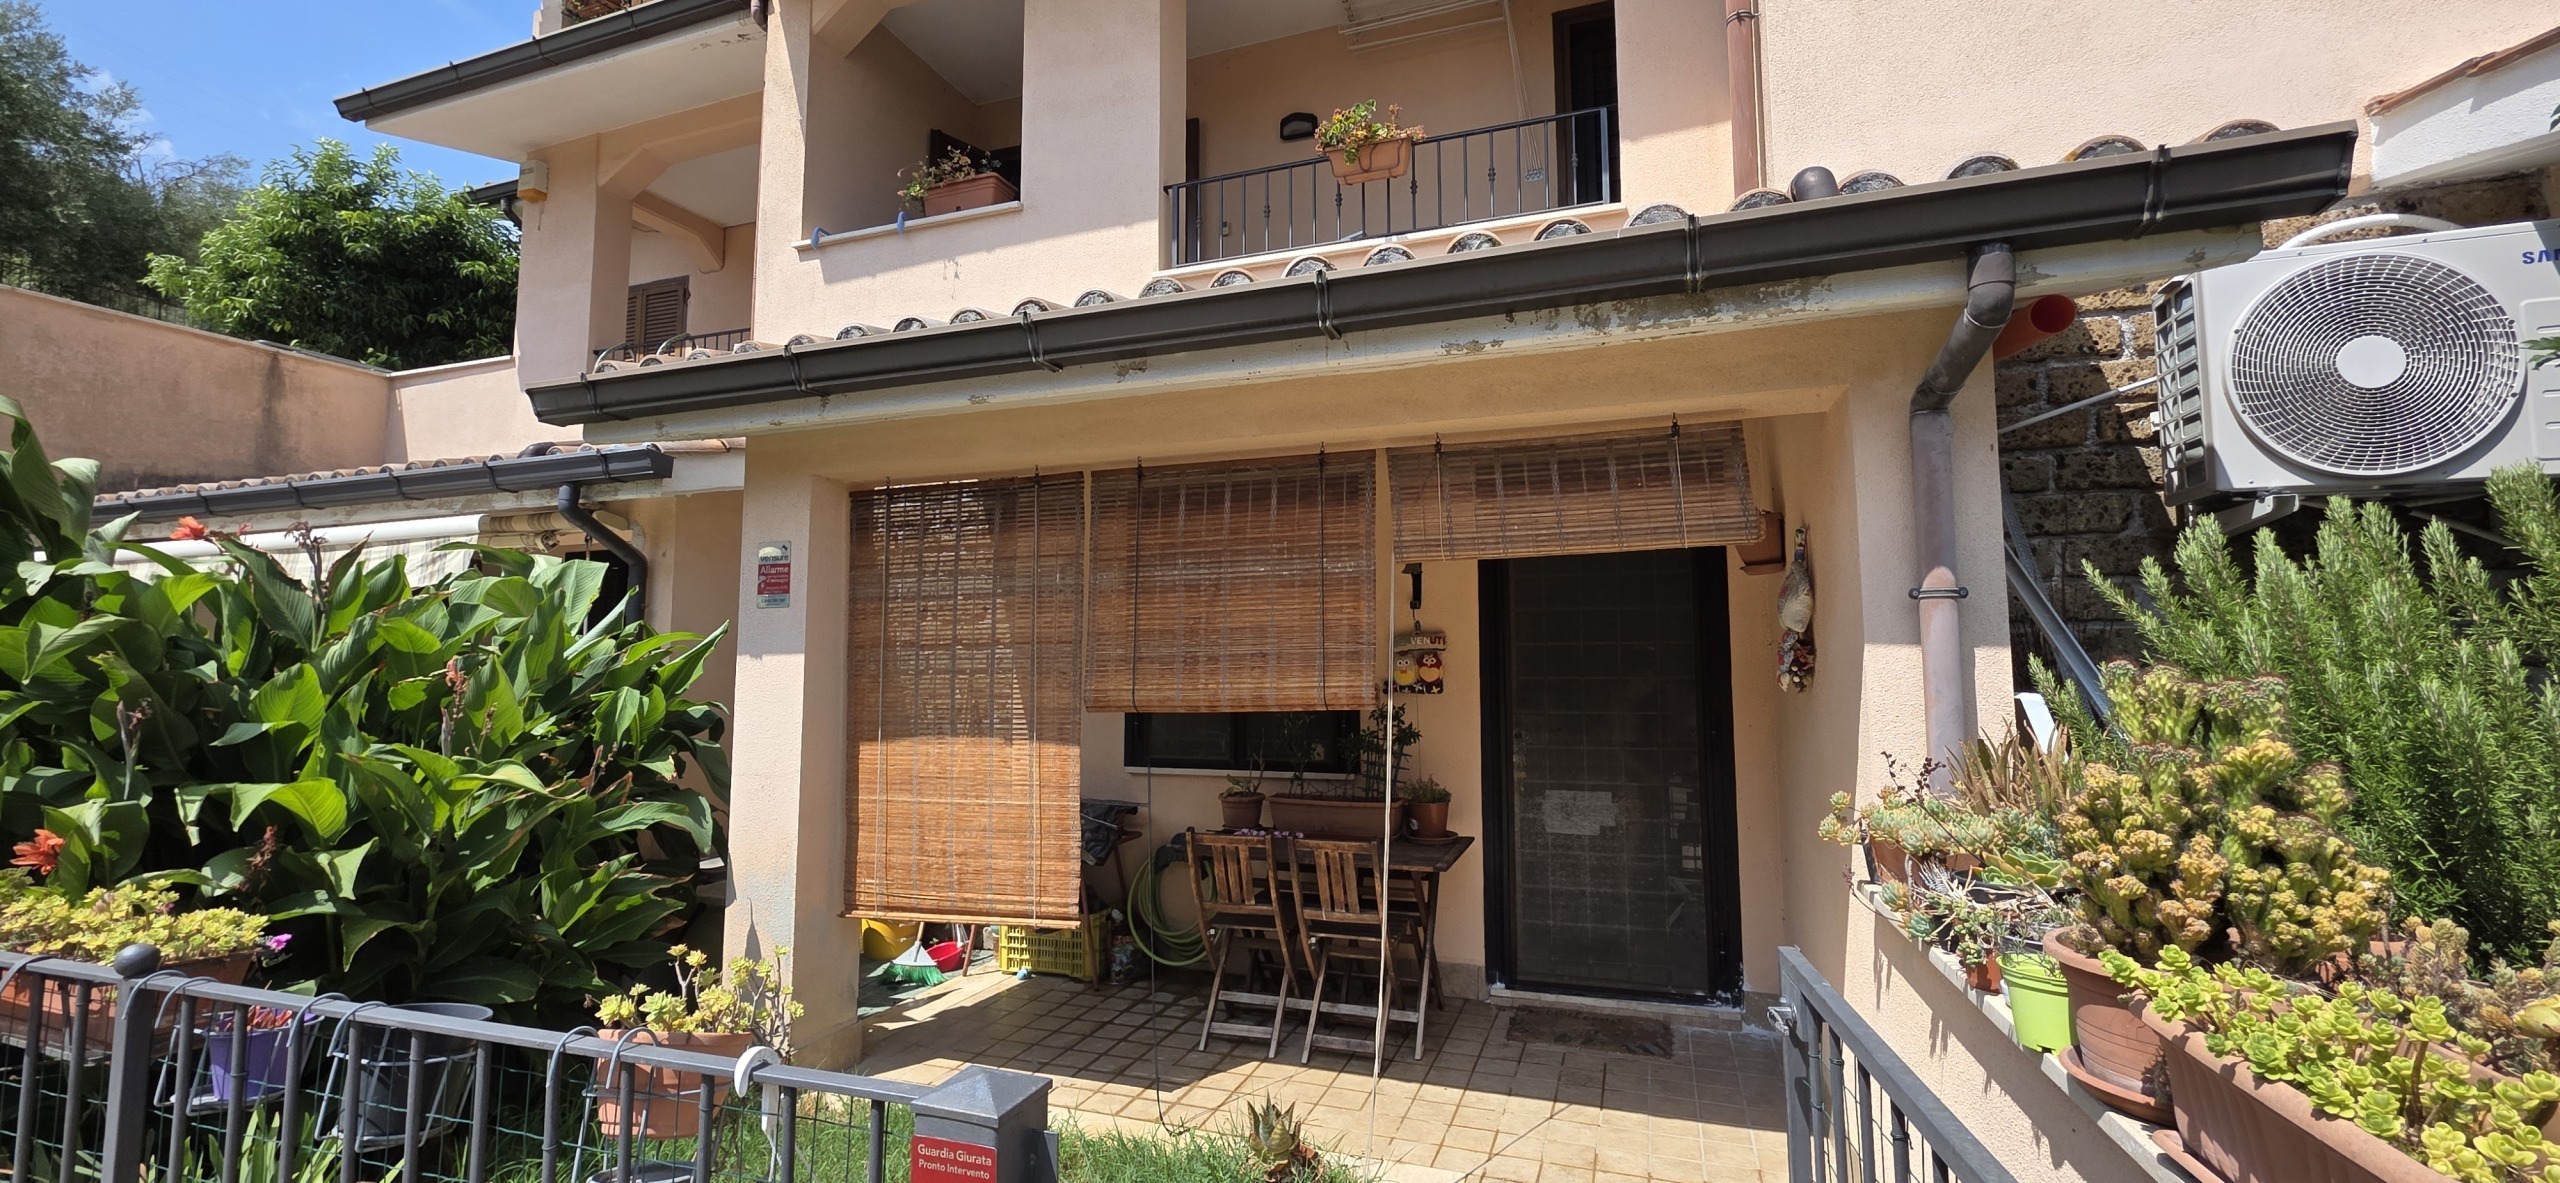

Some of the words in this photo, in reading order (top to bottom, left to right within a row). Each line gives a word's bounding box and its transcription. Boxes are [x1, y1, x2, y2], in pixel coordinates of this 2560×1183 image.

[760, 566, 789, 574] Allarme
[1395, 636, 1446, 648] VENUTI
[917, 1144, 954, 1159] Guardia
[956, 1151, 992, 1166] Giurata
[918, 1159, 946, 1171] Pronto
[947, 1164, 990, 1179] Intervento
